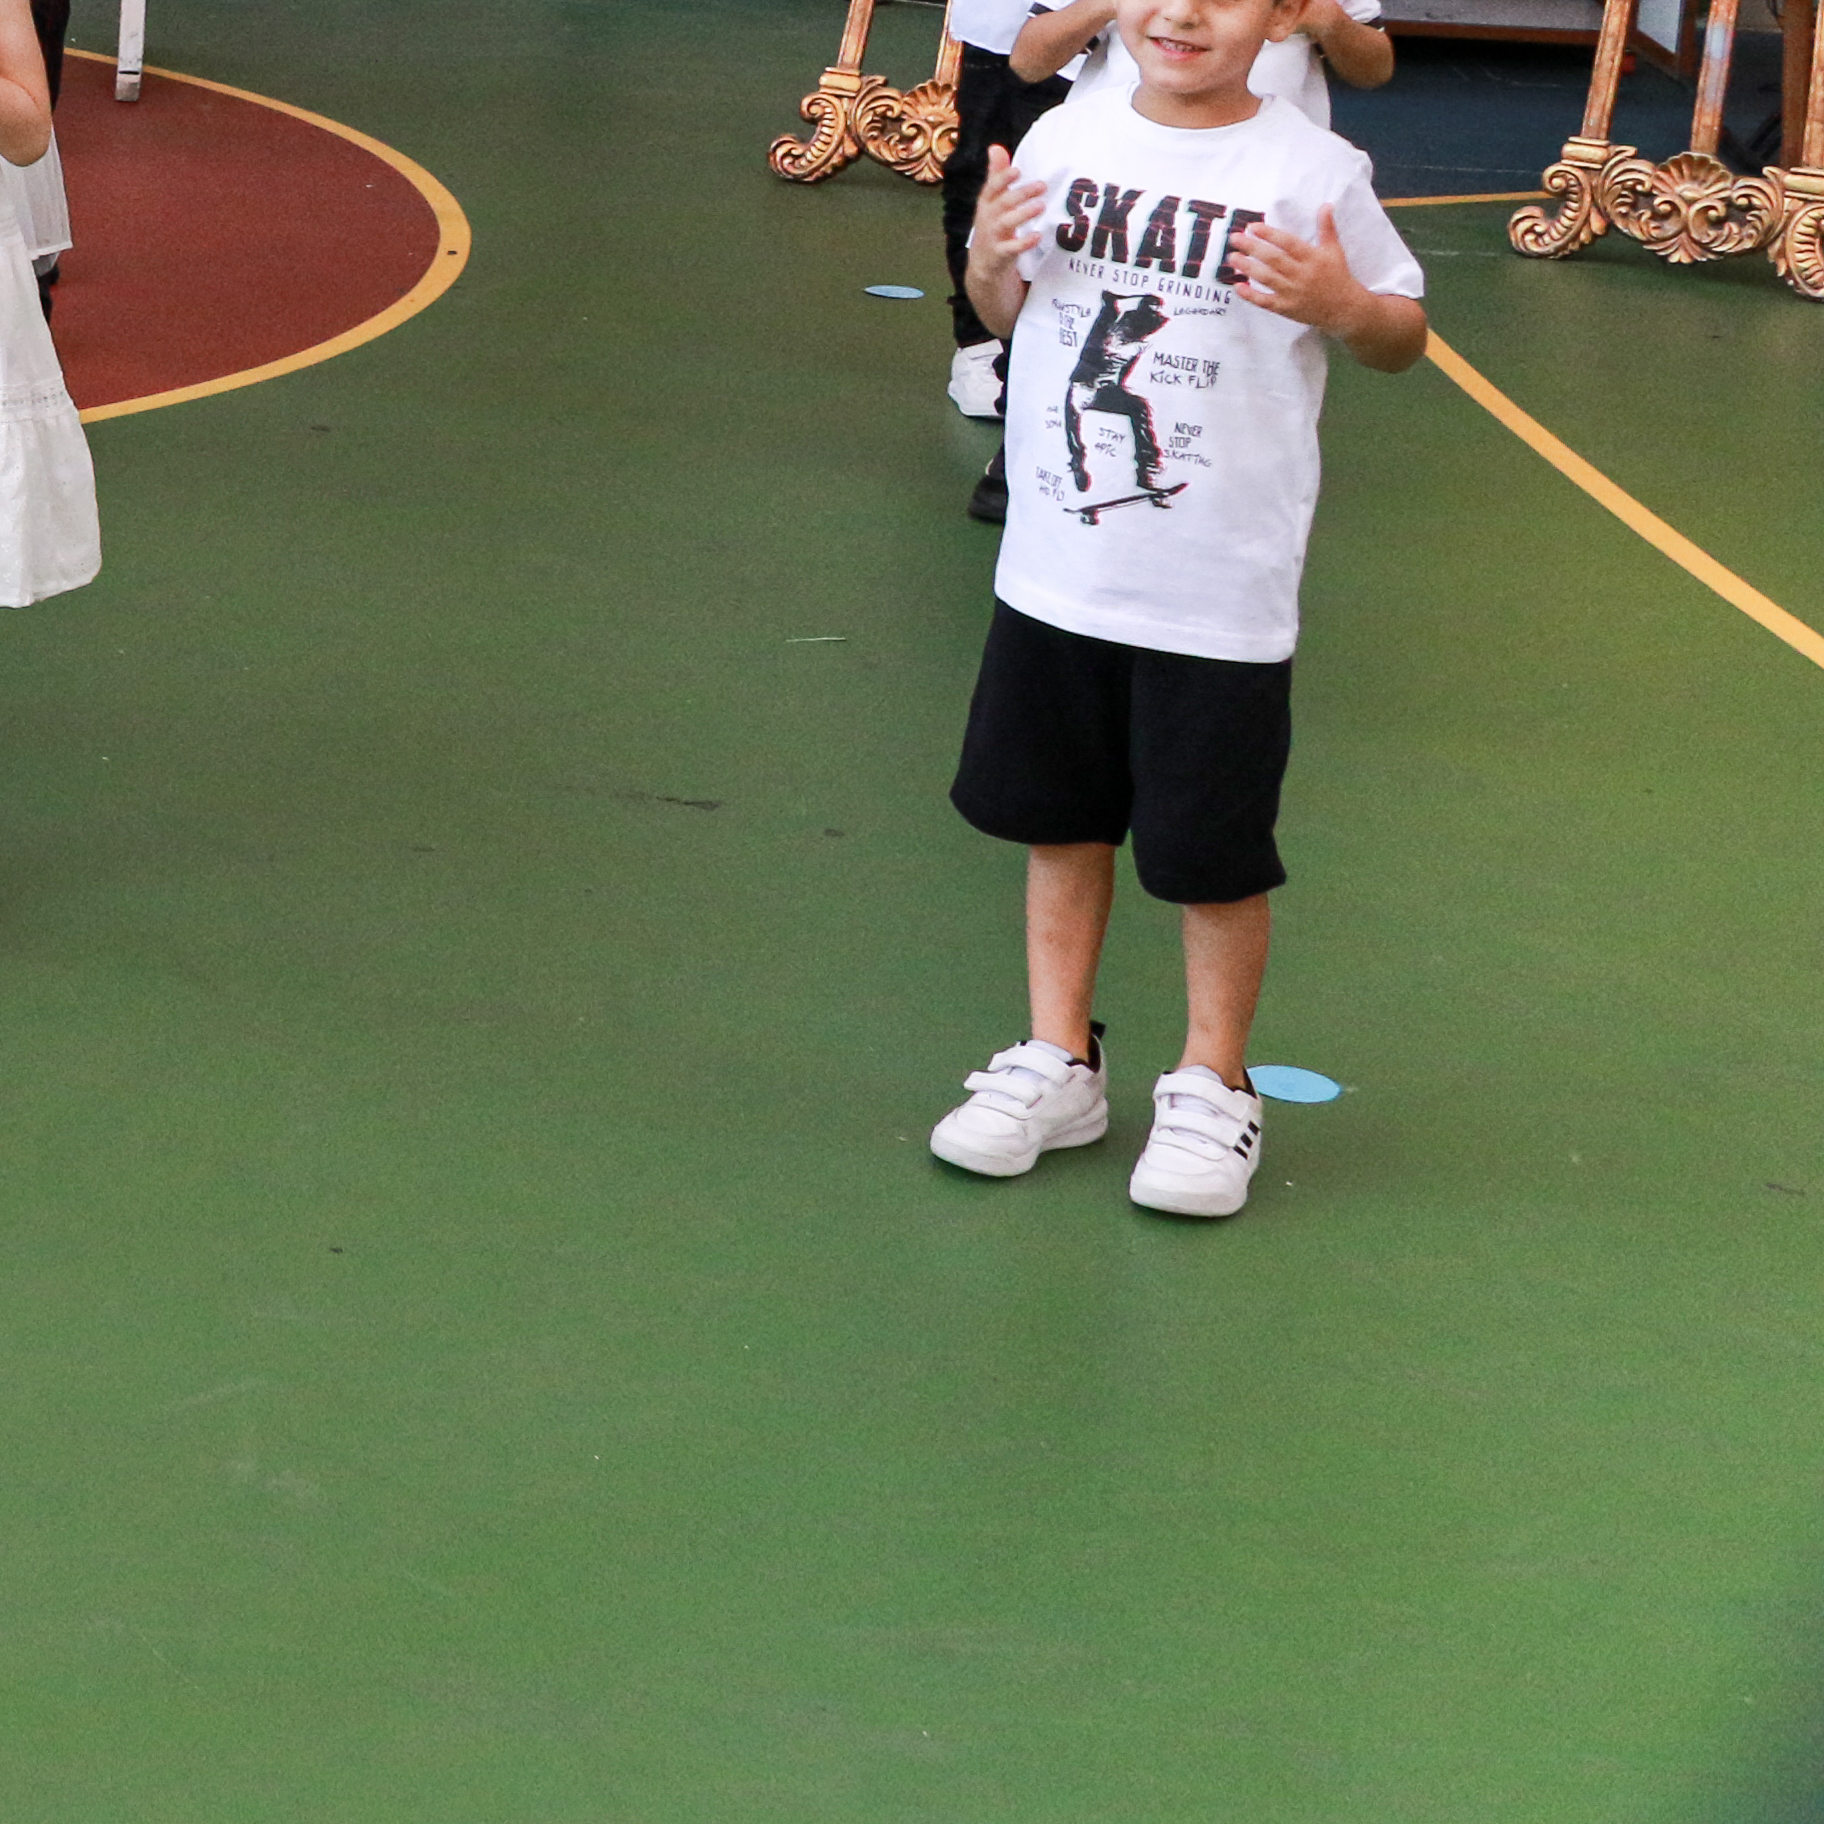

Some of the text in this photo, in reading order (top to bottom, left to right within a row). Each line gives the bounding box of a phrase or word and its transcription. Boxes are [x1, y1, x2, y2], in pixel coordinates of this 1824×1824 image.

[1056, 177, 1266, 286] SKATE
[1068, 257, 1233, 305] NEVER STOP GRINDING
[1152, 350, 1222, 376] MASTER THE
[1150, 369, 1182, 385] KICK
[1174, 422, 1203, 438] NEVER
[1169, 436, 1192, 448] STOP
